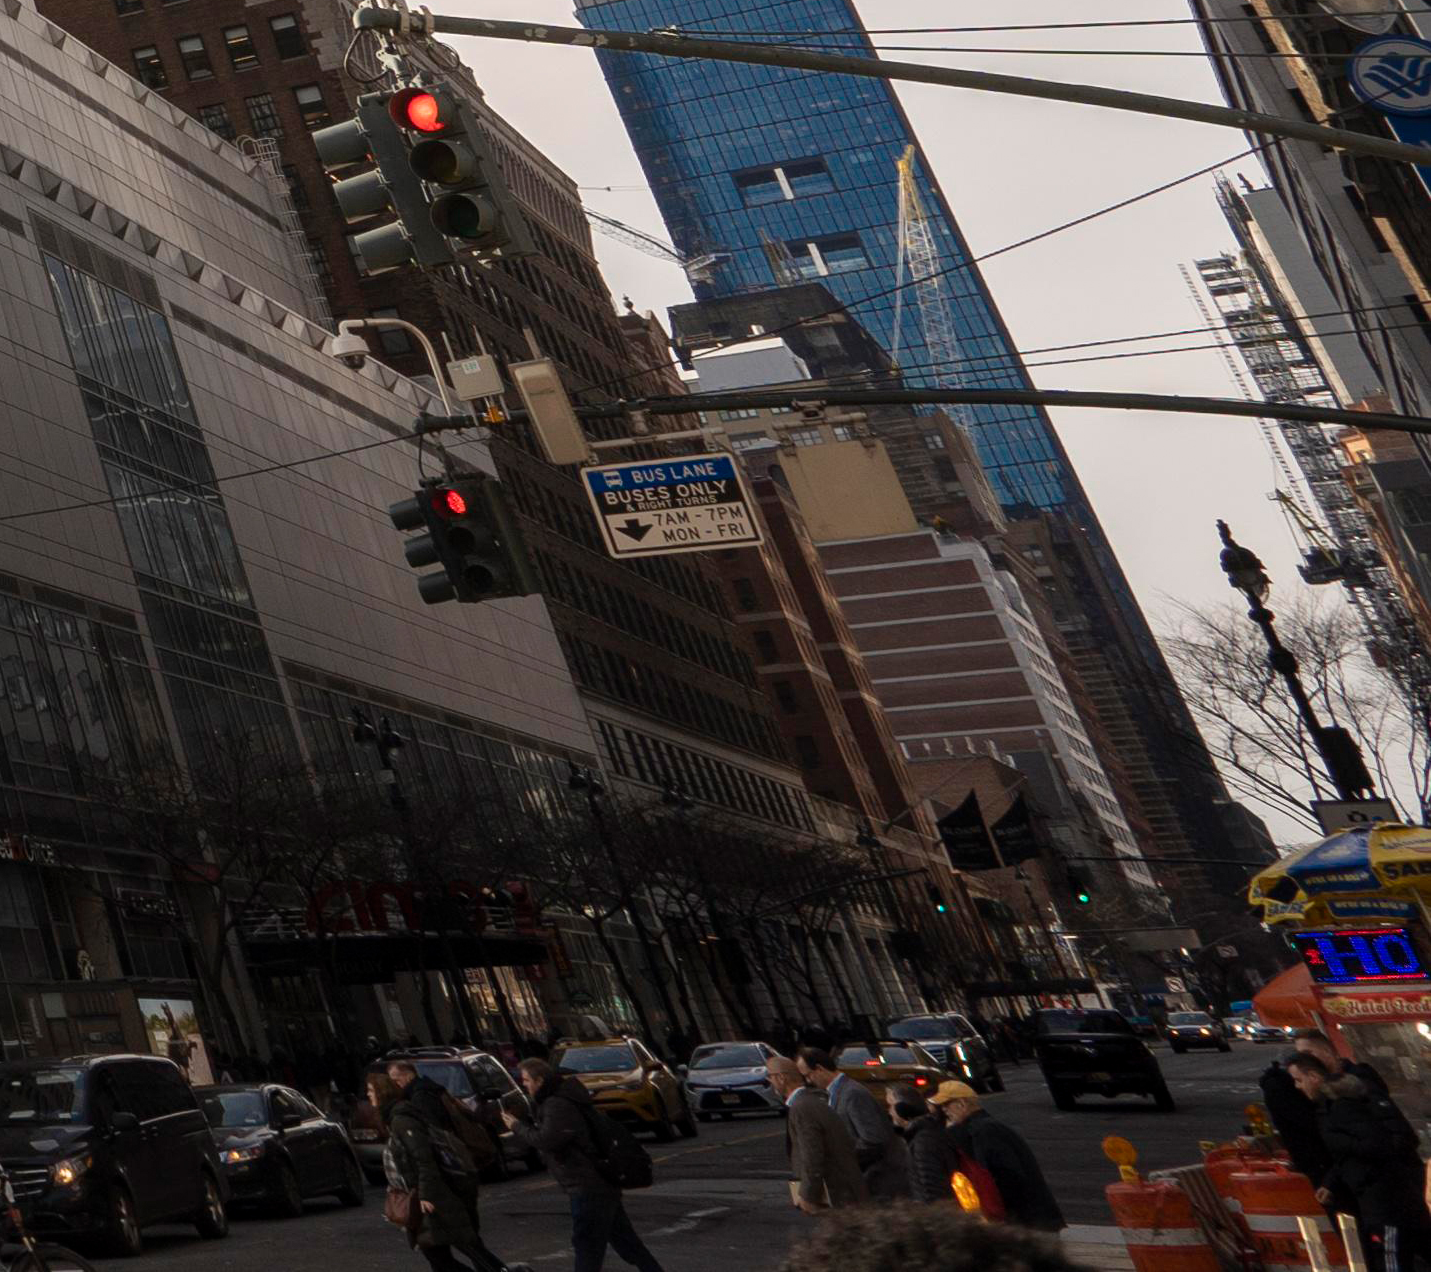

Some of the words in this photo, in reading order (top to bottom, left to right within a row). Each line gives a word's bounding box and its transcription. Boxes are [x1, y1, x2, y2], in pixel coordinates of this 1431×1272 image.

[631, 468, 667, 484] BUS
[669, 462, 718, 481] LANE
[604, 486, 670, 505] BUSES
[676, 480, 728, 498] ONLY
[626, 503, 636, 512] &
[638, 498, 675, 511] RIGHT
[676, 494, 718, 507] TURNS
[652, 510, 691, 527] 7AM
[705, 506, 744, 522] 7PM
[662, 527, 701, 543] MON
[717, 523, 746, 538] FRI
[1347, 998, 1394, 1017] Halal
